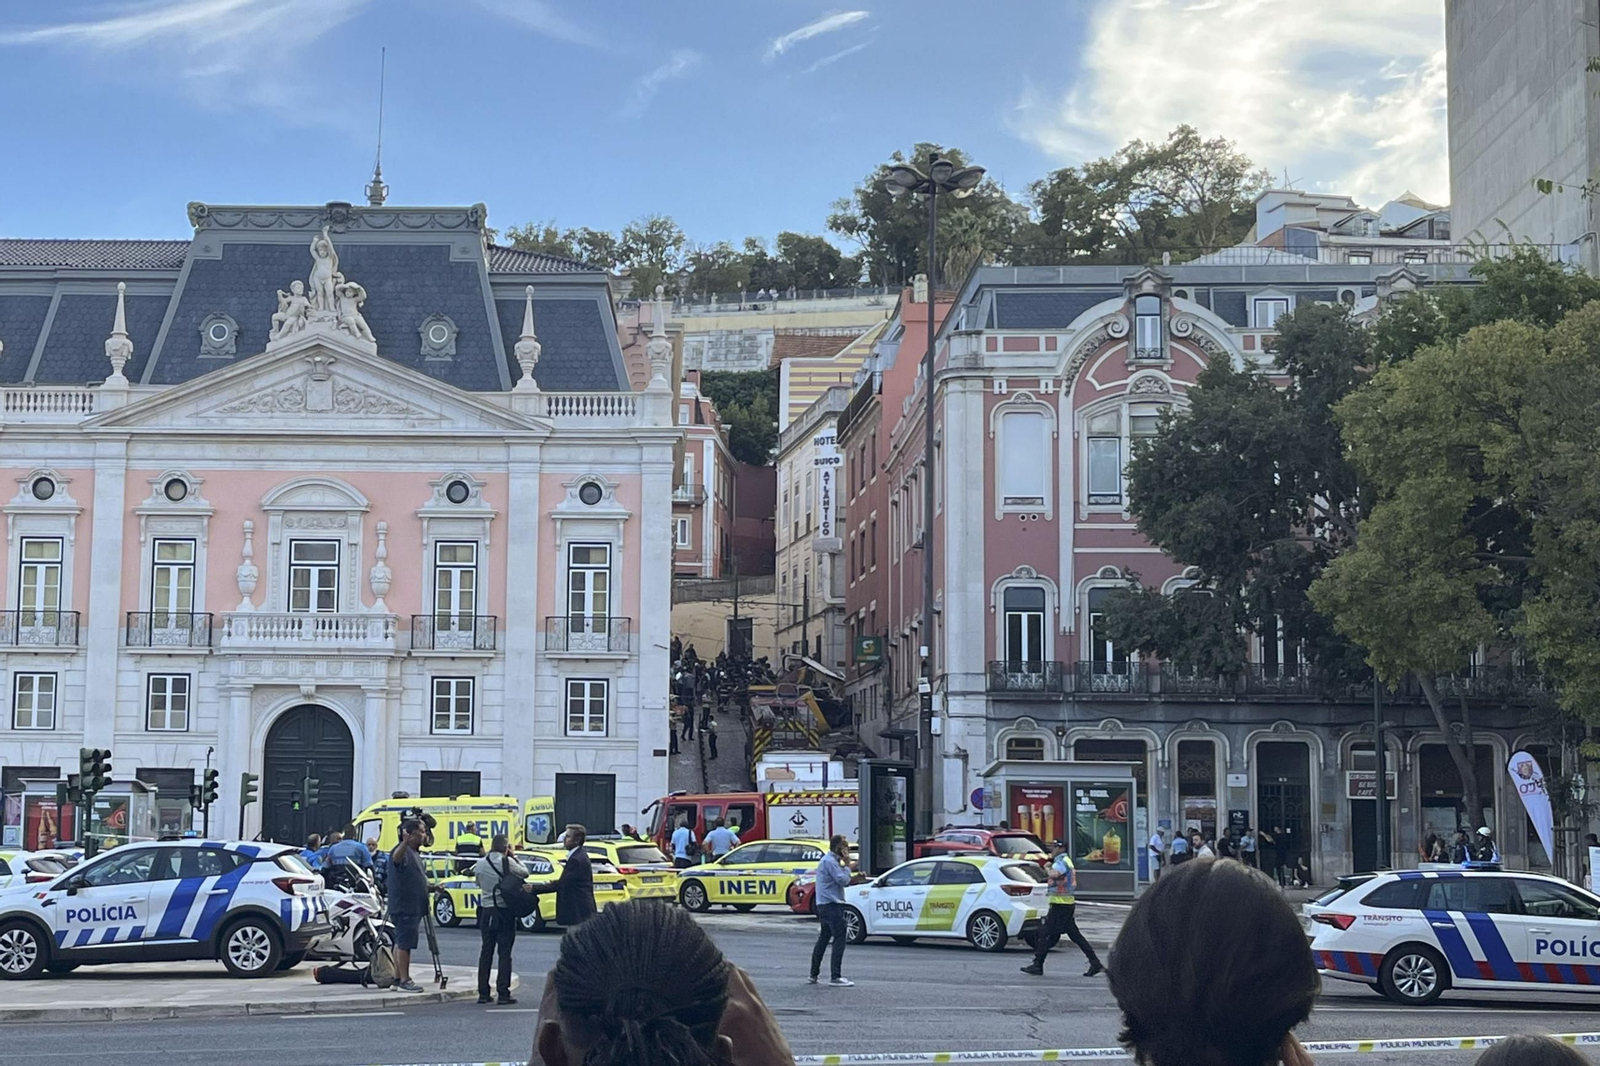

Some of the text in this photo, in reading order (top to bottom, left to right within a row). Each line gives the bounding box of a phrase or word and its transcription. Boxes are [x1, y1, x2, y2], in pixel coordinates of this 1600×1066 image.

[814, 436, 836, 445] HOTE
[719, 880, 776, 895] INEM
[465, 893, 481, 909] IN
[876, 899, 913, 911] POLÍCIA
[65, 904, 138, 924] POLÍCIA
[1536, 935, 1600, 957] POLÍC
